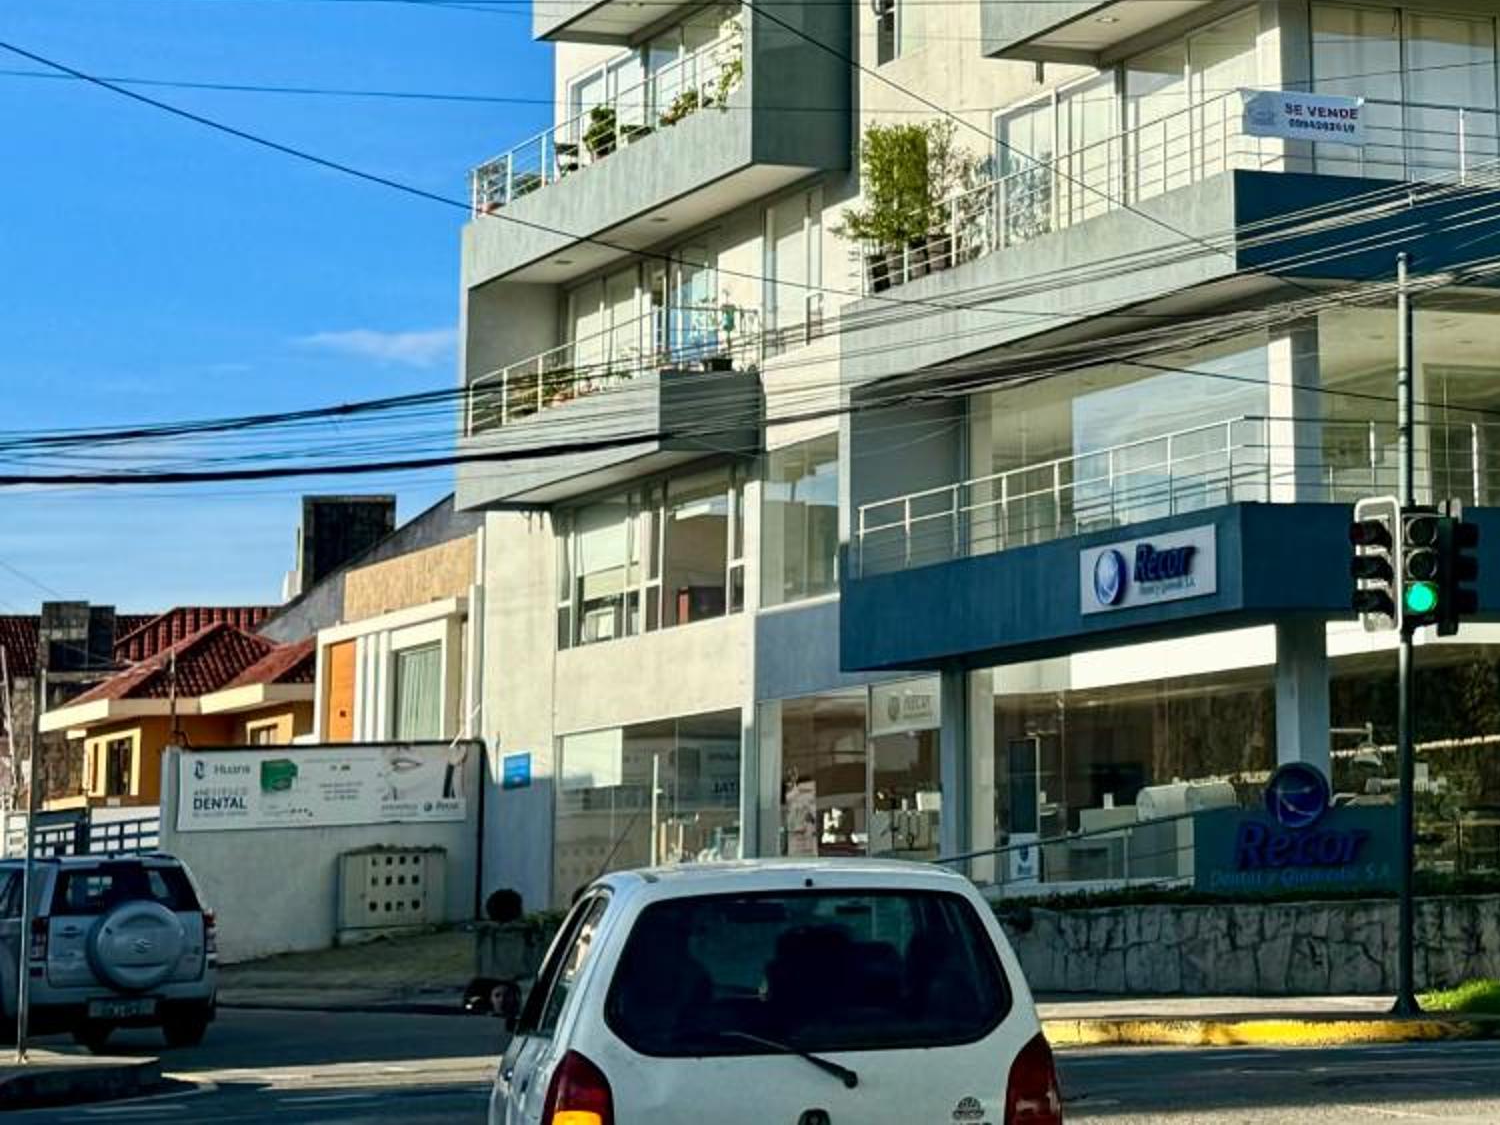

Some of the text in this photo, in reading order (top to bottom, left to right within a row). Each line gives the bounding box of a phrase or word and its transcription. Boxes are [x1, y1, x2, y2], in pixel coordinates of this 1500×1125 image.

[1284, 103, 1359, 119] SE VENDE
[1134, 543, 1196, 582] Recor
[193, 795, 248, 811] DENTAL
[1235, 820, 1371, 870] Recor
